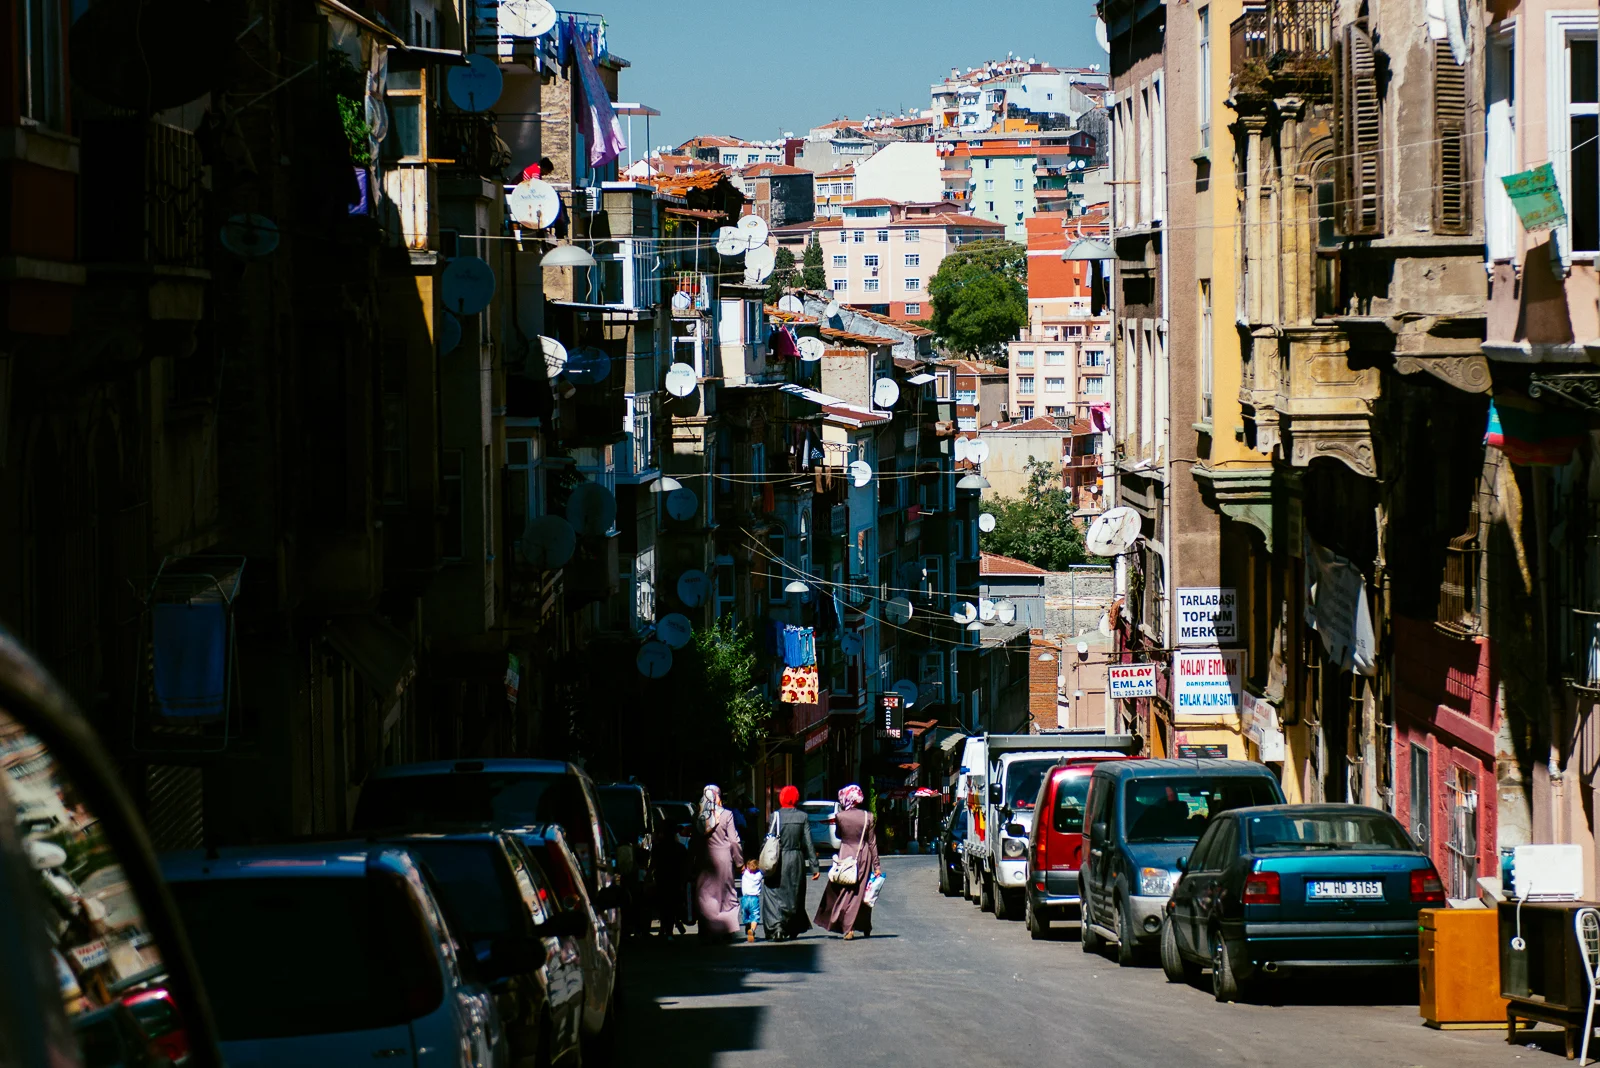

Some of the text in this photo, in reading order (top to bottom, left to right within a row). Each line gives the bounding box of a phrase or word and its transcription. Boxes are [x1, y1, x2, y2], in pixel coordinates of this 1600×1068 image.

[1180, 595, 1235, 608] TARLABAŞI
[1182, 611, 1233, 622] TOPLUM
[1181, 624, 1235, 637] MERKEZİ
[1111, 668, 1152, 678] KALAY
[1180, 659, 1237, 676] KALAY EMLAK
[1112, 680, 1154, 689] EMLAK
[1179, 693, 1239, 706] EMLAK ALIM-SATIM
[876, 729, 901, 739] HOUSE
[1316, 882, 1328, 894] 34
[1352, 882, 1379, 894] 3165
